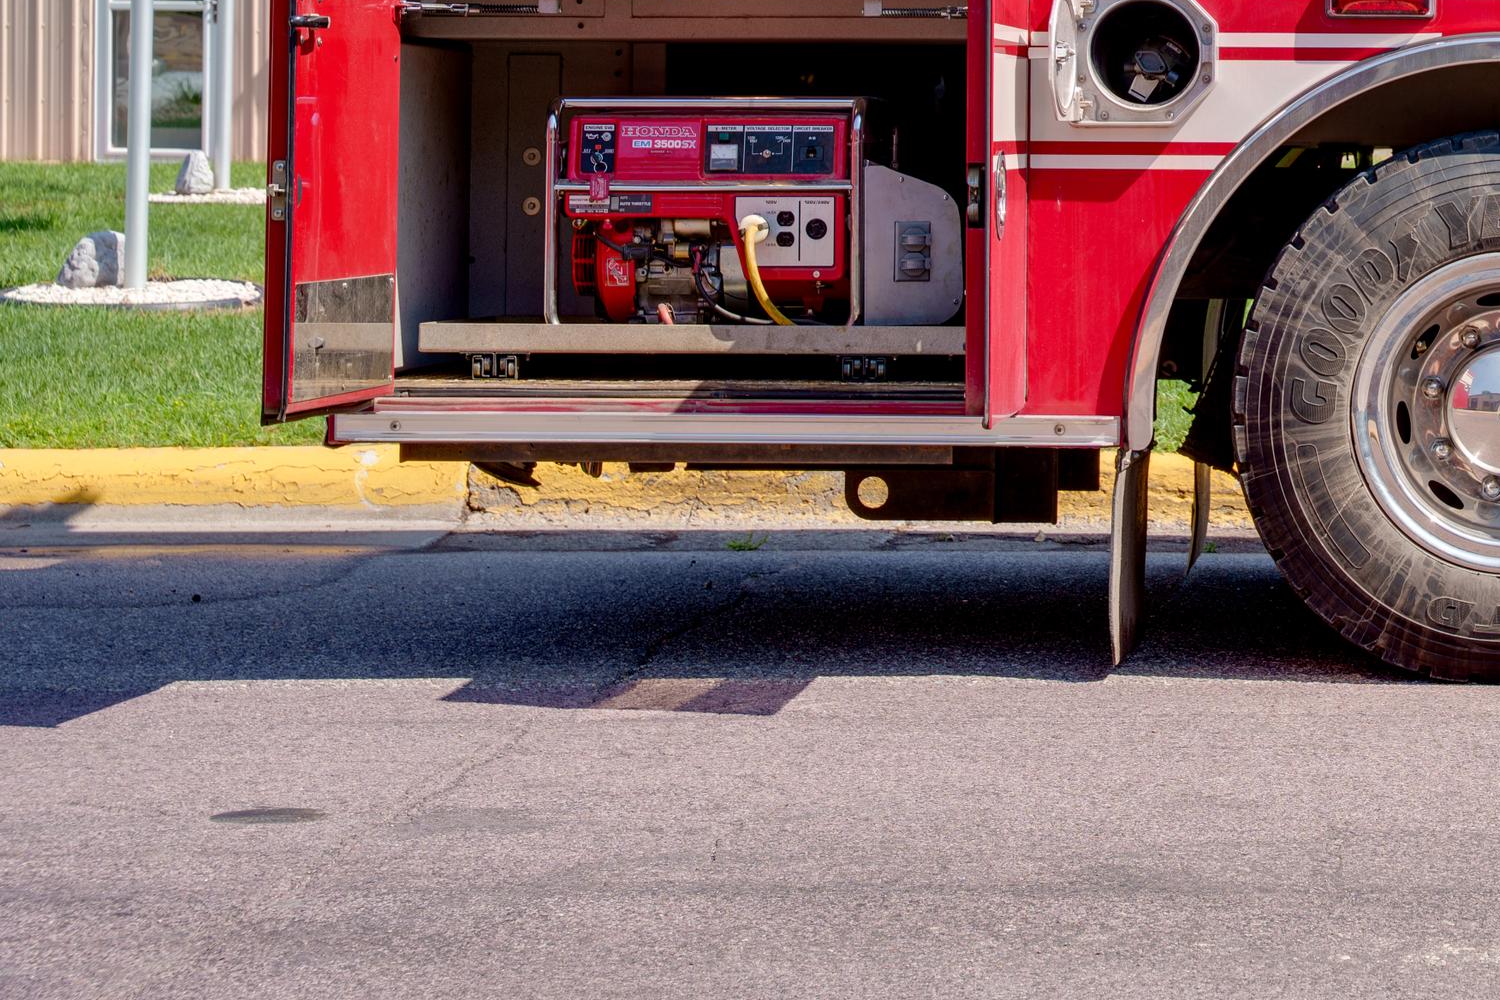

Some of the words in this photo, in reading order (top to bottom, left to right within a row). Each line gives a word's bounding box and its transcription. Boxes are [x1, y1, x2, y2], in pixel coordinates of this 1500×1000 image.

[621, 125, 697, 138] HONDA
[633, 140, 651, 148] EM
[654, 139, 697, 149] 3500SX
